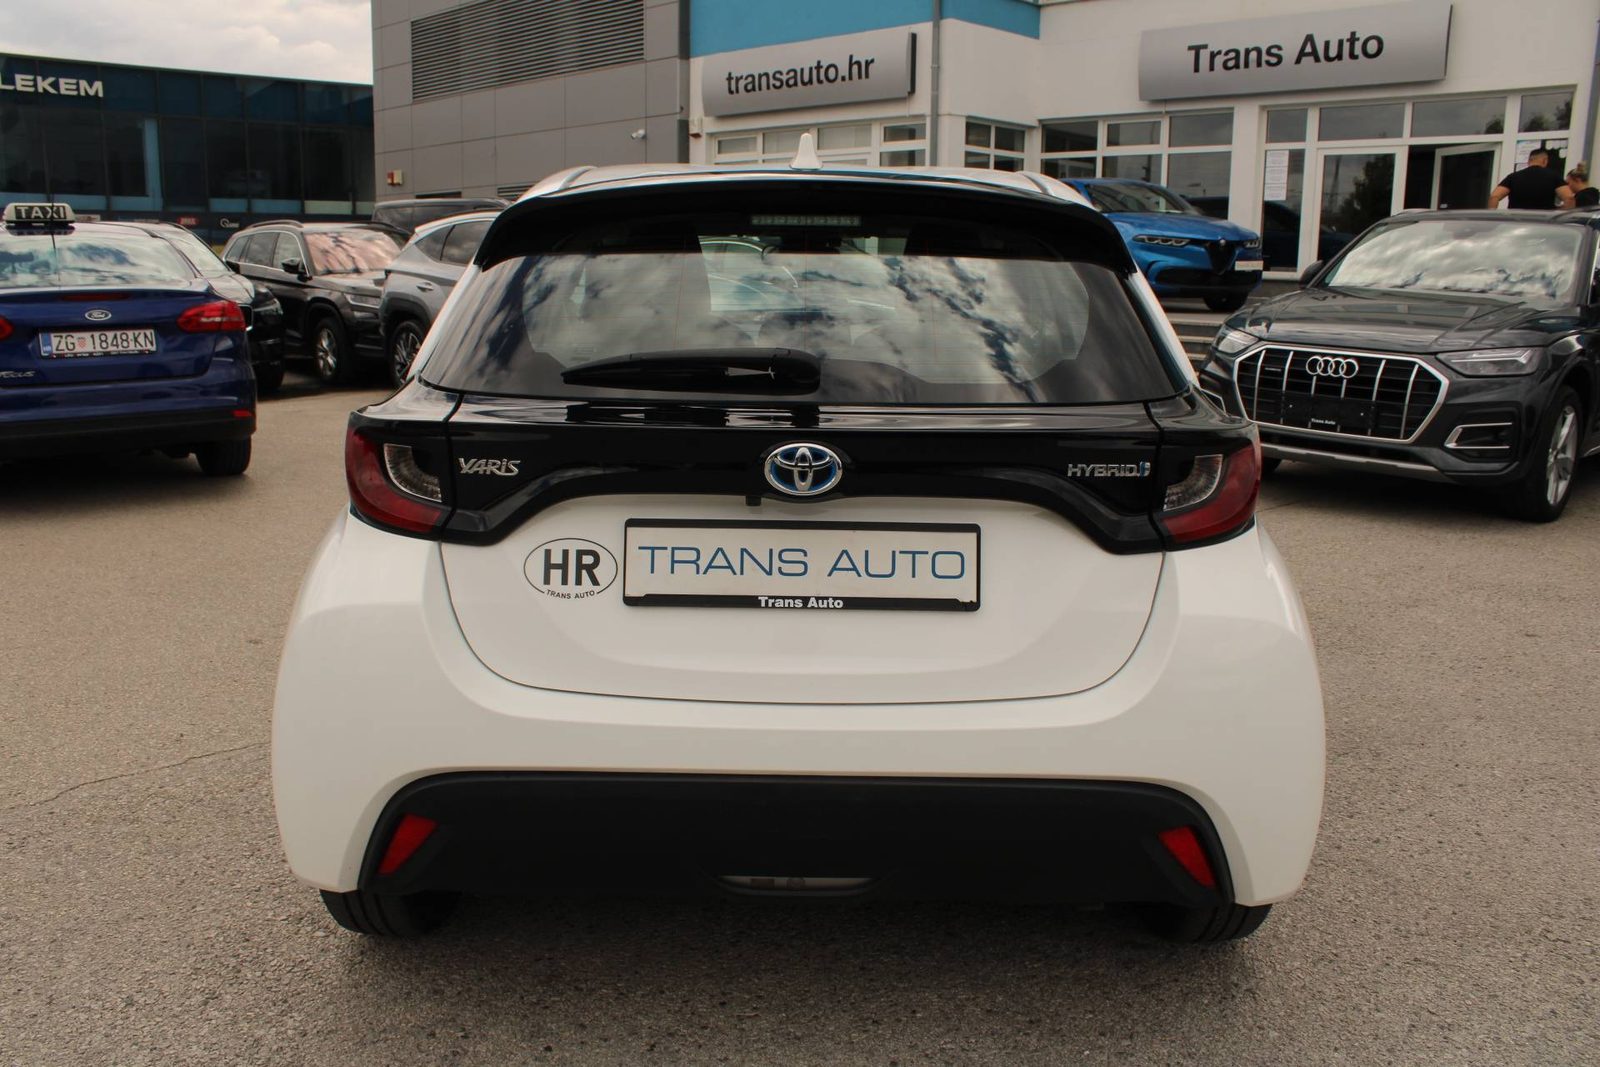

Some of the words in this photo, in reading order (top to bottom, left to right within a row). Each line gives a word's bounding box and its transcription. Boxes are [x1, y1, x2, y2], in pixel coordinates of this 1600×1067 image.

[1187, 44, 1284, 73] Trans
[1294, 31, 1384, 65] Auto
[0, 72, 104, 98] LEKEM
[726, 54, 875, 95] transauto.hr
[16, 206, 66, 219] TAXI
[53, 334, 76, 352] ZG
[1067, 463, 1139, 477] HYBRID
[543, 548, 601, 586] HR
[638, 546, 808, 577] TRANS
[827, 549, 965, 579] AUTO
[546, 589, 571, 599] TRANS
[574, 590, 595, 599] AUTO
[758, 596, 803, 608] Trans
[807, 597, 843, 609] Auto
